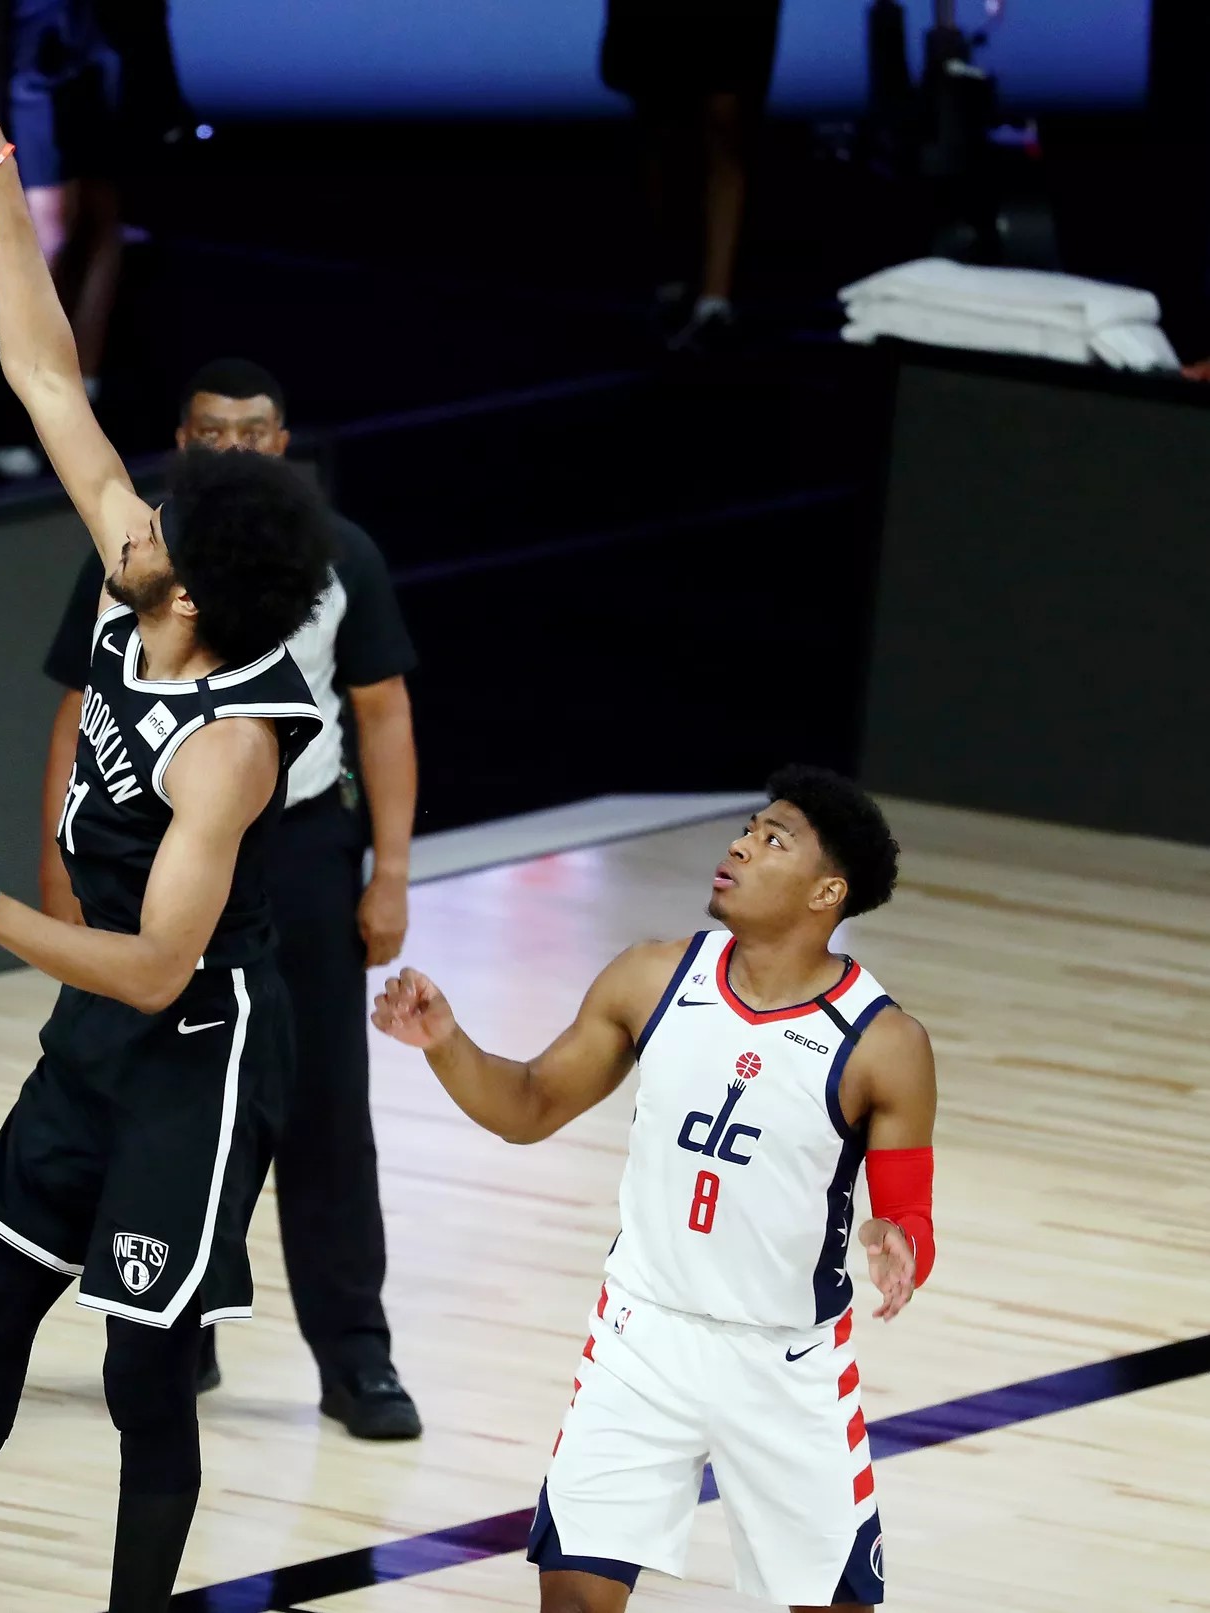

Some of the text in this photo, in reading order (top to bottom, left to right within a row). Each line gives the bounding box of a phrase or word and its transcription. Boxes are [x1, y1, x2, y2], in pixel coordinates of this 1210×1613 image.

[147, 712, 167, 738] infor
[79, 684, 143, 805] ROOKLYN
[783, 1029, 829, 1055] GEICO
[688, 1170, 720, 1234] 8
[116, 1235, 164, 1267] NETS
